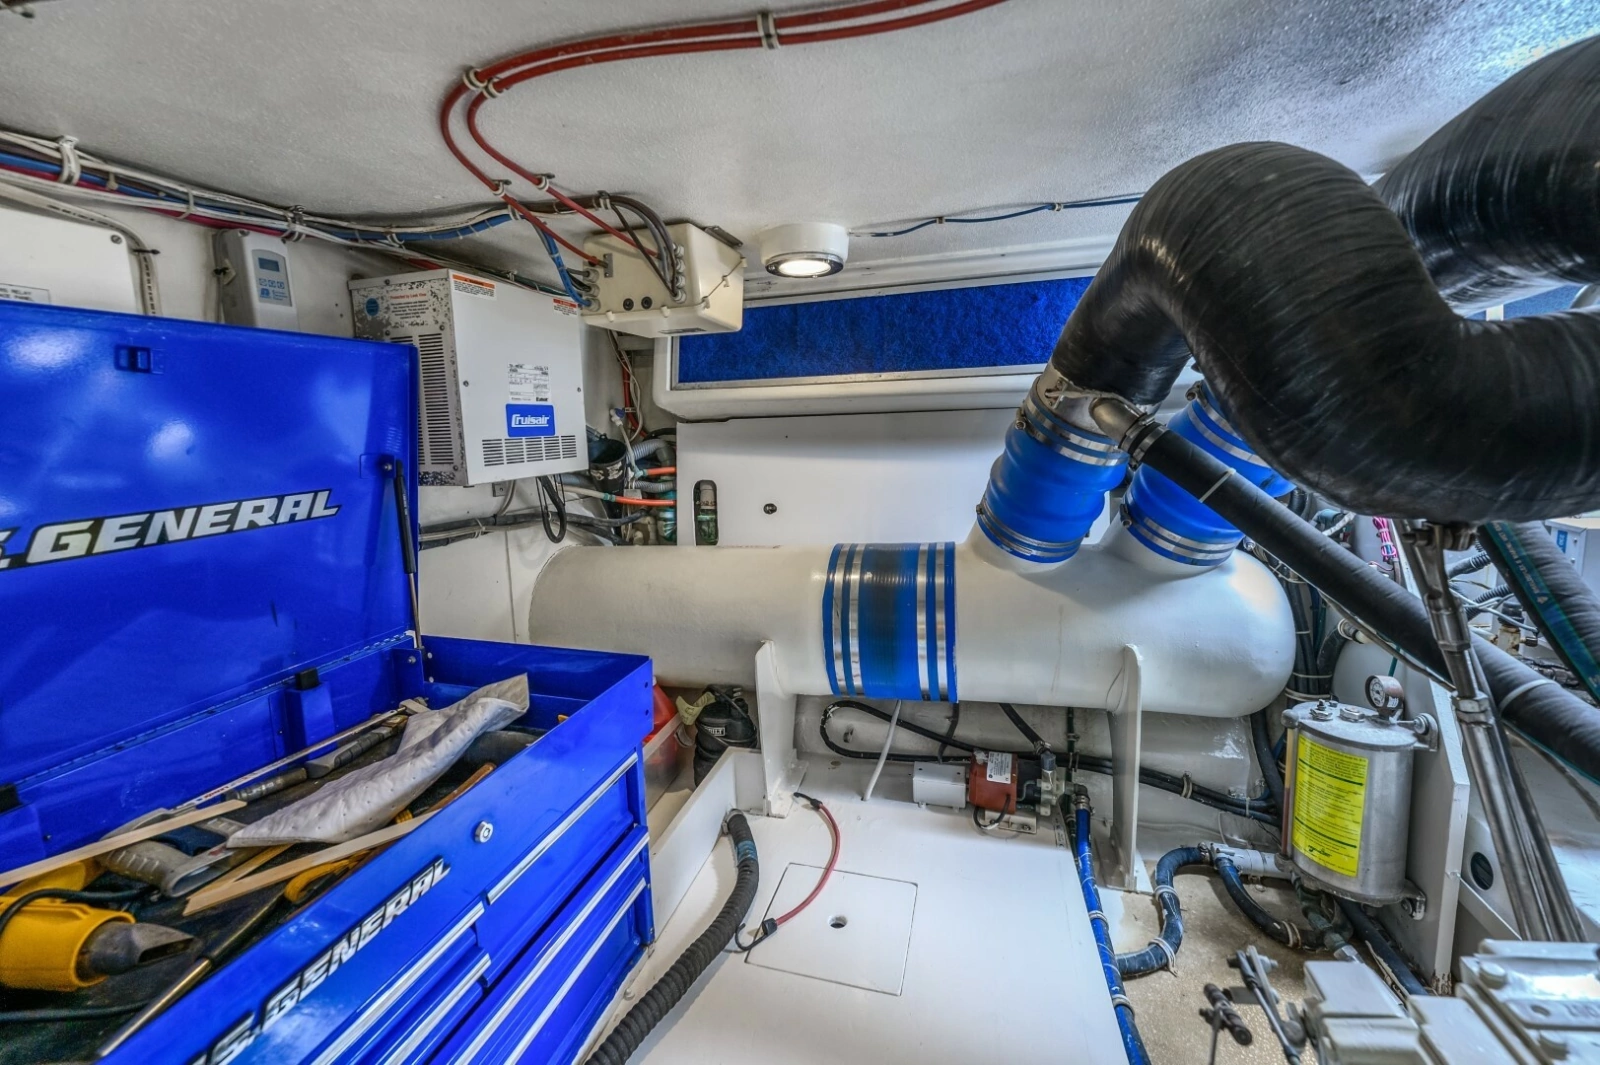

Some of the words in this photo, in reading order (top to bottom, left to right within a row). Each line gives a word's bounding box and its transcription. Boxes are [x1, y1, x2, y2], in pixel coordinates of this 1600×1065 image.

[511, 414, 549, 428] Cruisair
[26, 490, 340, 564] GENERAL
[262, 857, 451, 1032] GENERAL
